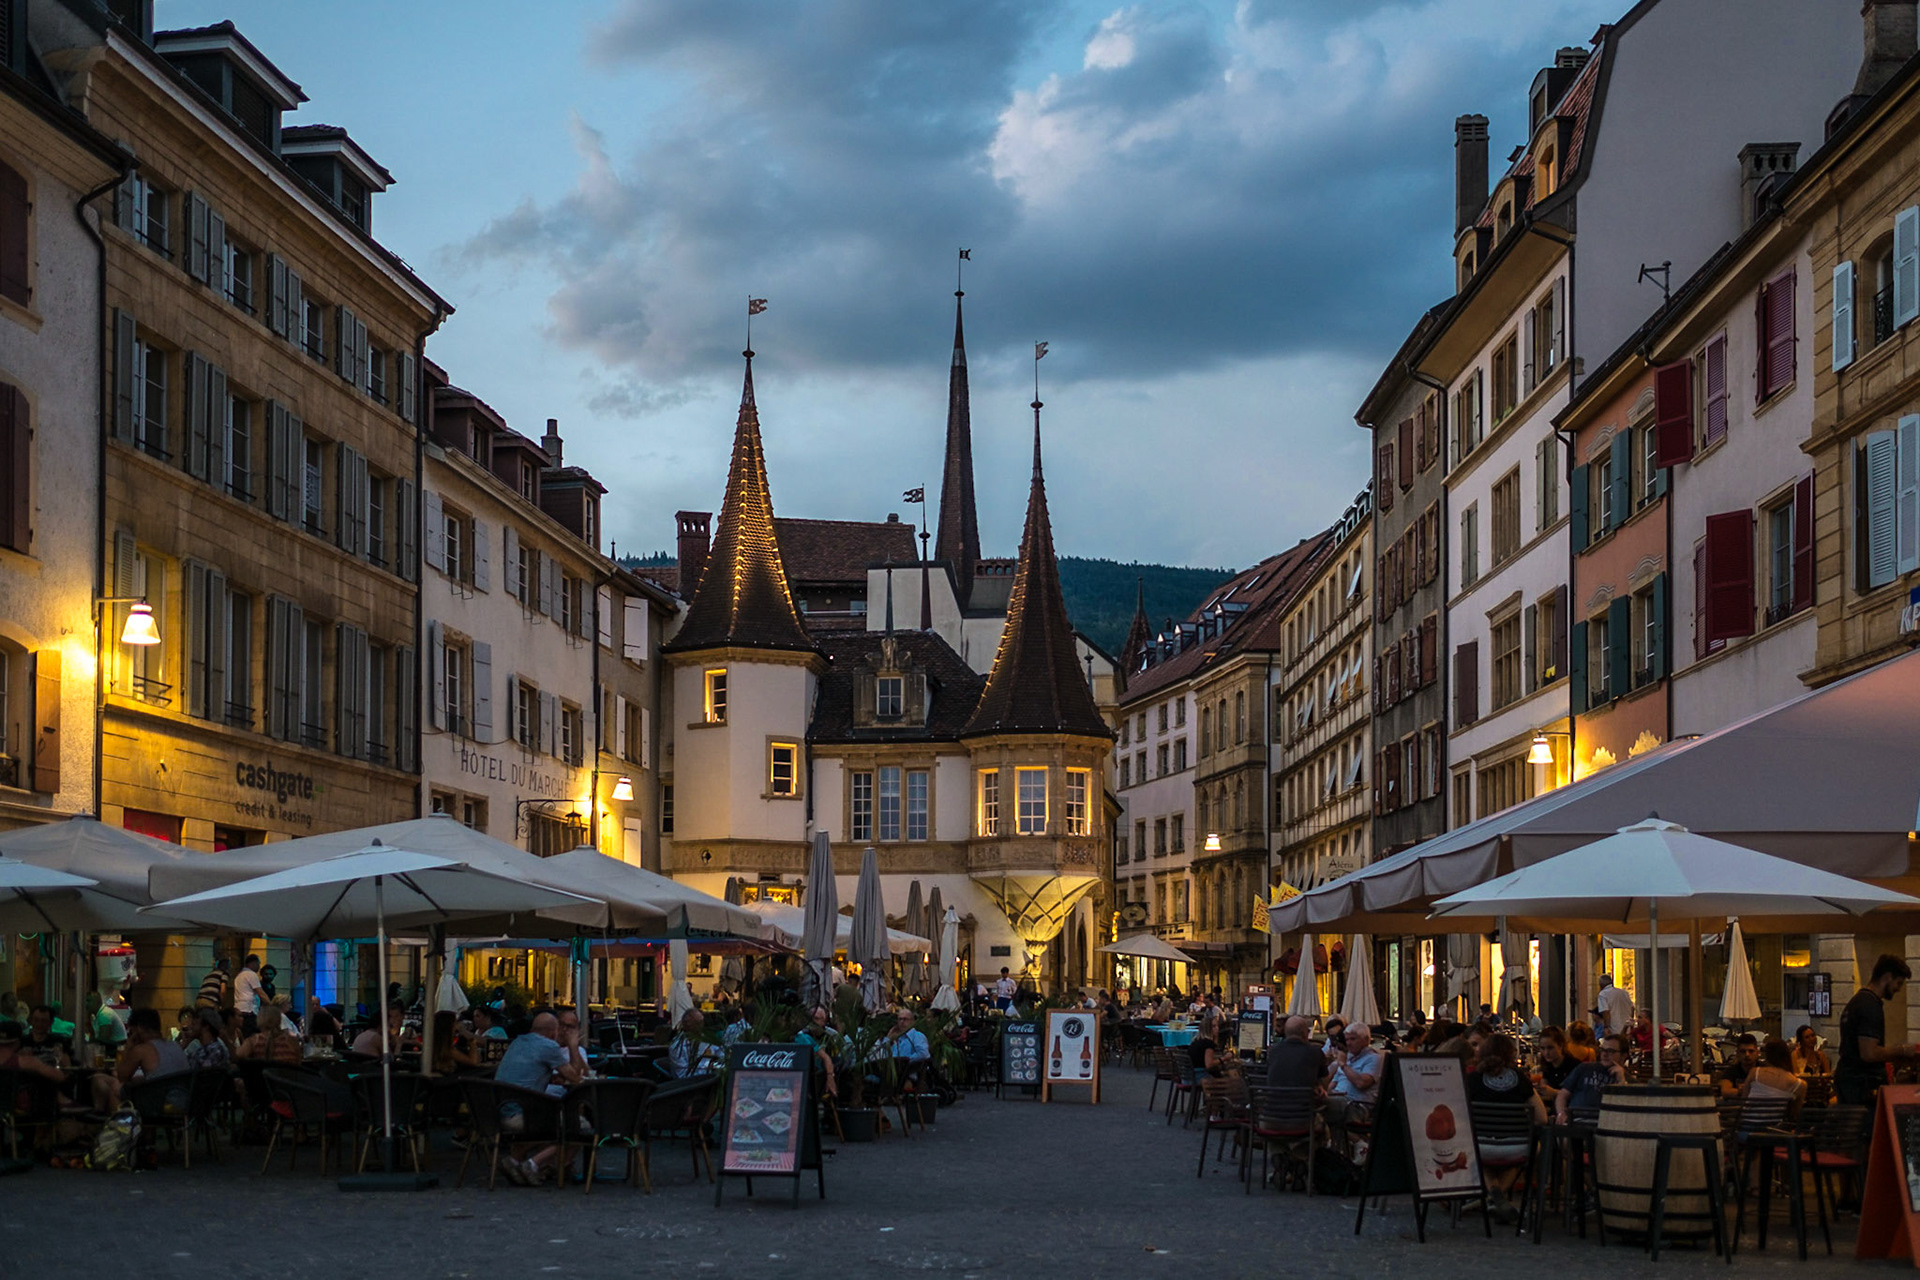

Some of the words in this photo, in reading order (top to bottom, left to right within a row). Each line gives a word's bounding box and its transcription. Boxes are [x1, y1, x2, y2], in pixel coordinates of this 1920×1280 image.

[236, 761, 313, 804] cashgate
[511, 763, 526, 787] DU
[234, 800, 265, 818] credit
[268, 804, 276, 819] &
[278, 806, 312, 829] leasing
[742, 1050, 797, 1069] Coca-Cola
